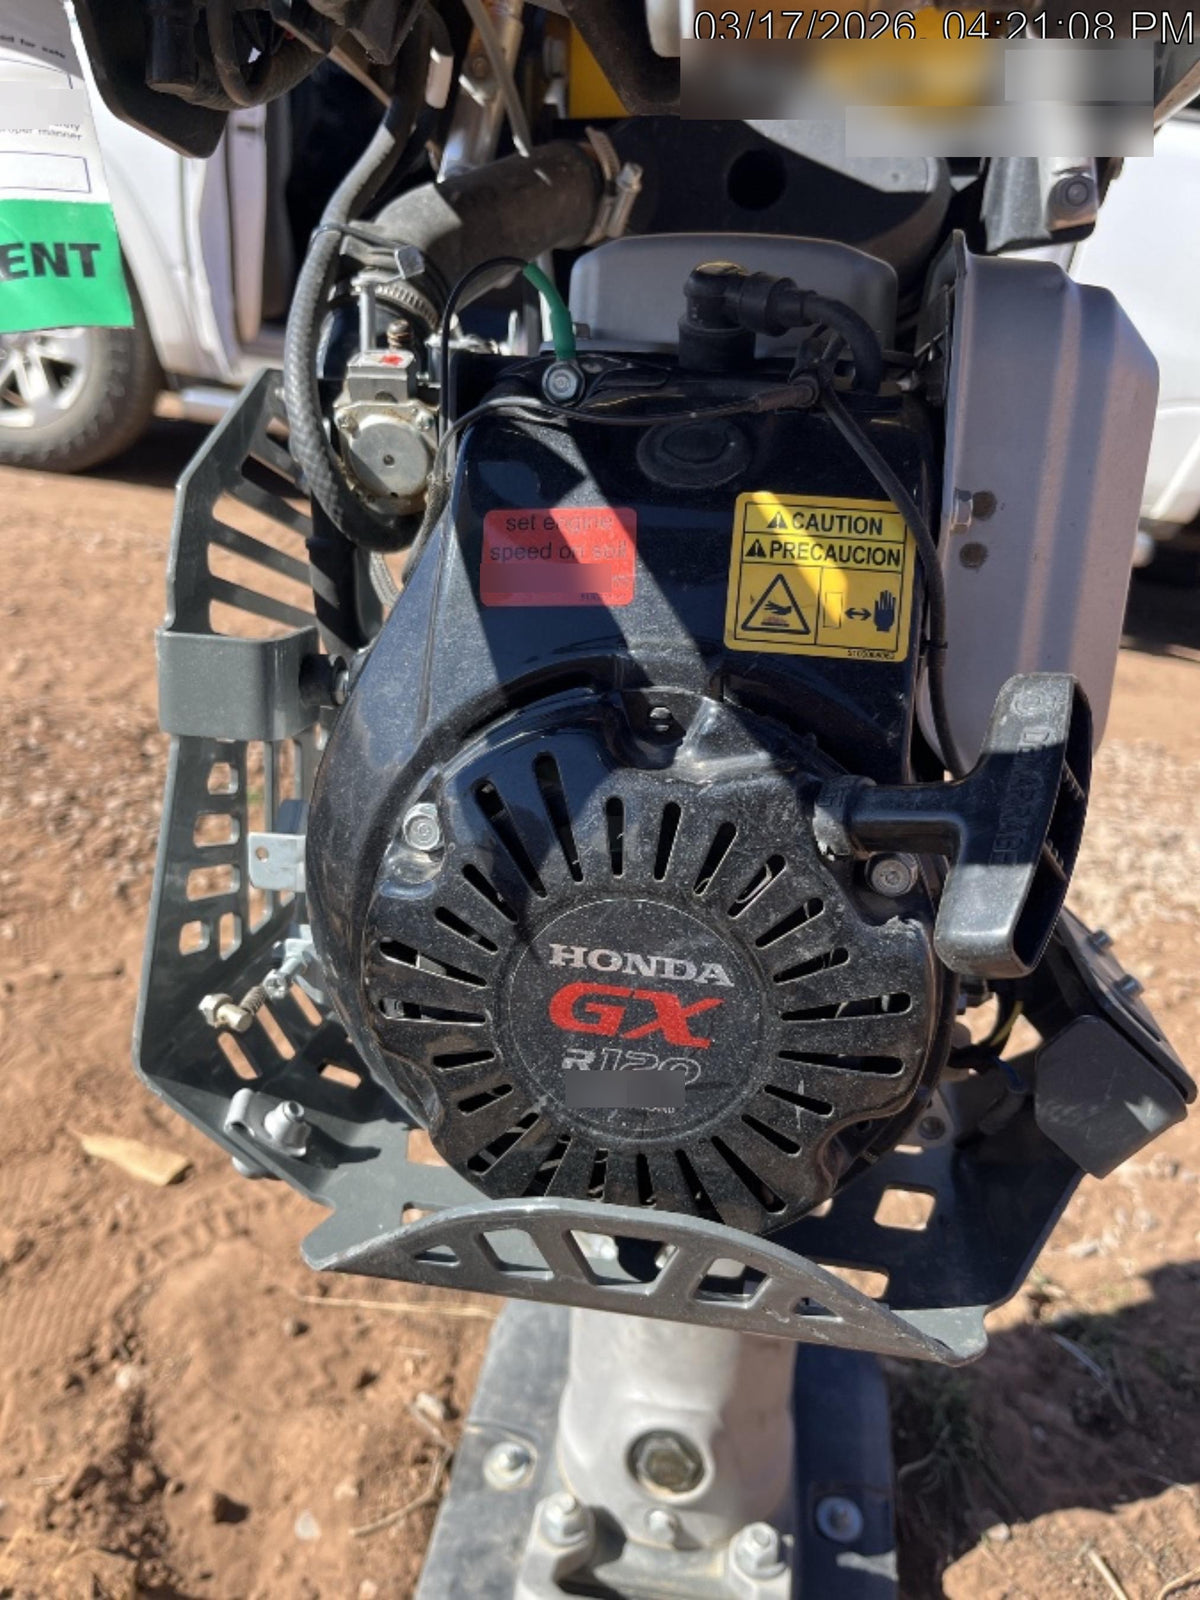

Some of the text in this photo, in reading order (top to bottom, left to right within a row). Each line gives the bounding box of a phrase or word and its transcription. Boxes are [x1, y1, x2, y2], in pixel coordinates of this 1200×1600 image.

[0, 241, 102, 281] ENT
[505, 515, 613, 536] set engine
[792, 511, 883, 536] CAUTION
[490, 541, 552, 563] speed
[559, 545, 585, 560] on
[769, 540, 901, 567] PRECAUCION
[548, 943, 735, 988] HONDA
[548, 981, 726, 1050] GX
[560, 1047, 702, 1086] R120
